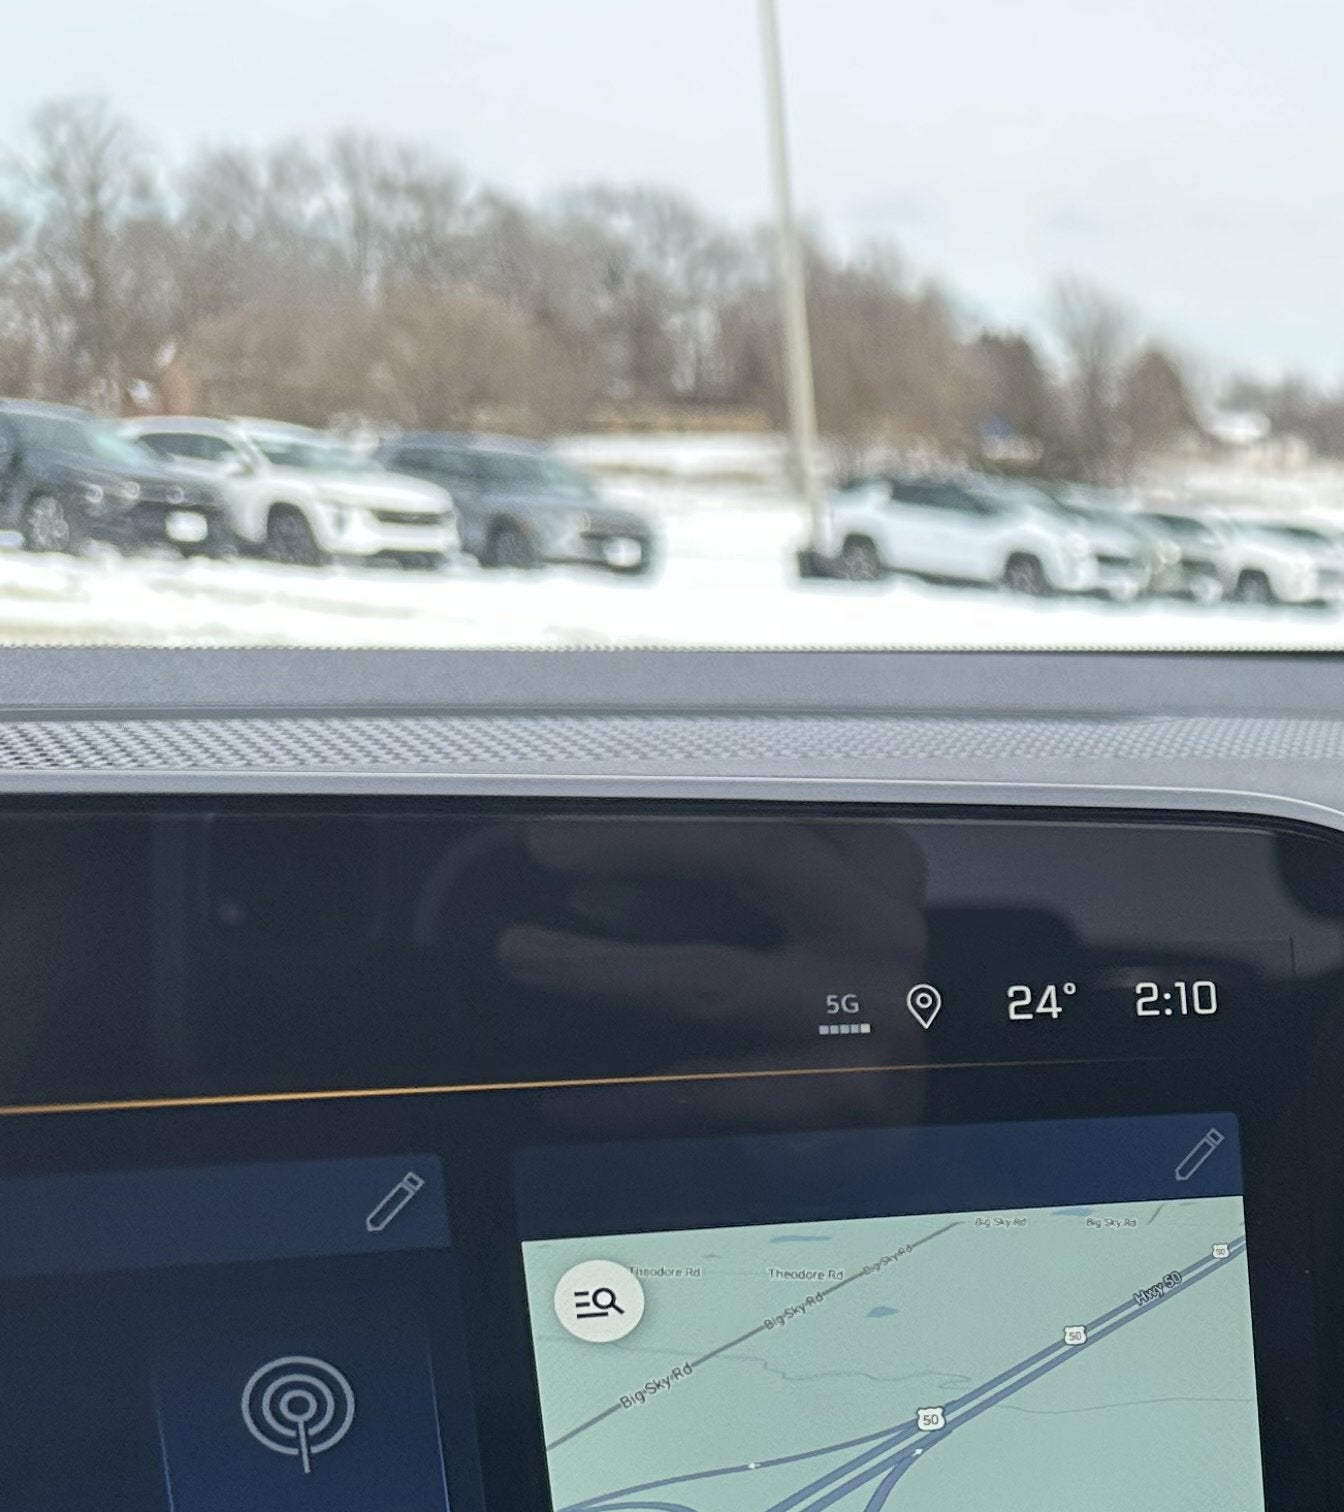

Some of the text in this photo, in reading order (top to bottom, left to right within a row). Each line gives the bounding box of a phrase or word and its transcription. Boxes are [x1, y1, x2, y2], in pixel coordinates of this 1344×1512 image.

[826, 994, 859, 1014] 5G
[1007, 982, 1076, 1020] 24°
[1135, 980, 1217, 1017] 2:10
[768, 1268, 844, 1281] Theodore Rd
[1162, 1270, 1183, 1288] 50
[763, 1291, 824, 1330] Big Sky Rd
[1068, 1331, 1082, 1342] 50
[619, 1361, 693, 1409] Big Sky Rd
[922, 1414, 939, 1426] 50
